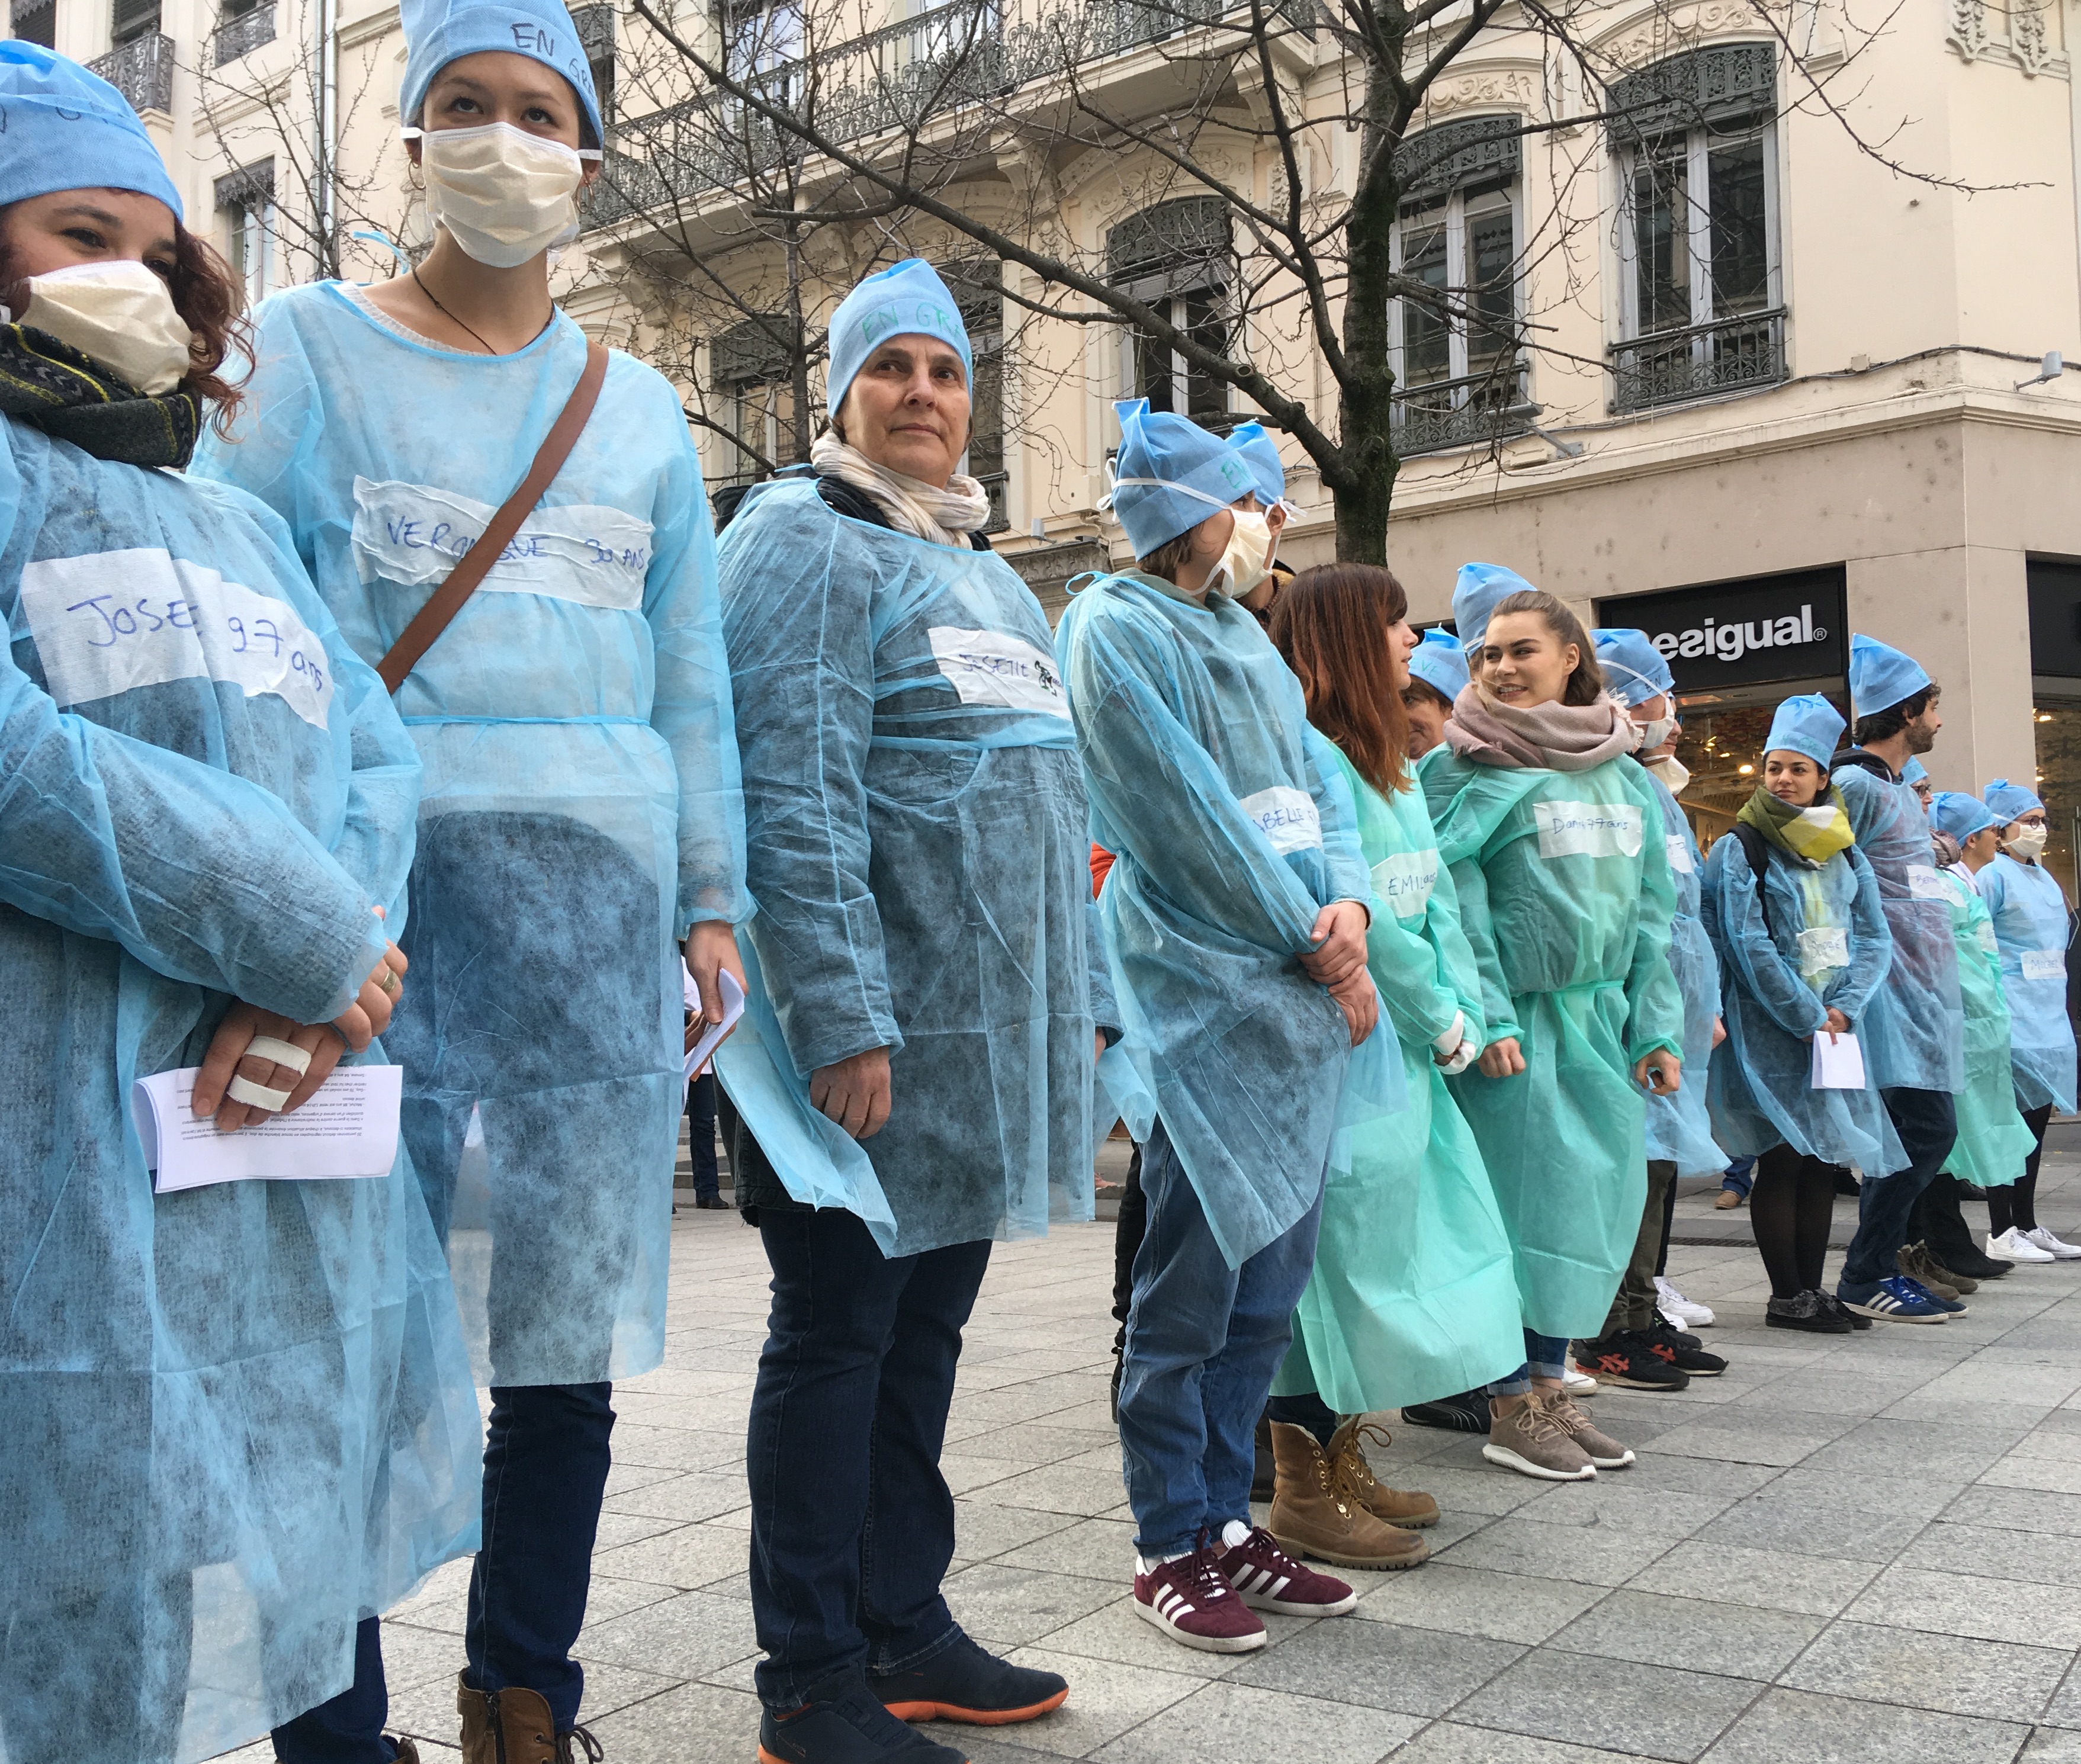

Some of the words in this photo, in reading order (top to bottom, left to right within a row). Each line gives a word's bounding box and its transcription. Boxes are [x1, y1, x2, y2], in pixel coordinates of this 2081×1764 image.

[510, 23, 554, 57] EN
[862, 305, 900, 345] EN
[622, 548, 644, 570] ANS
[1652, 604, 1813, 661] esigual
[228, 616, 284, 657] 97
[291, 650, 323, 692] ans
